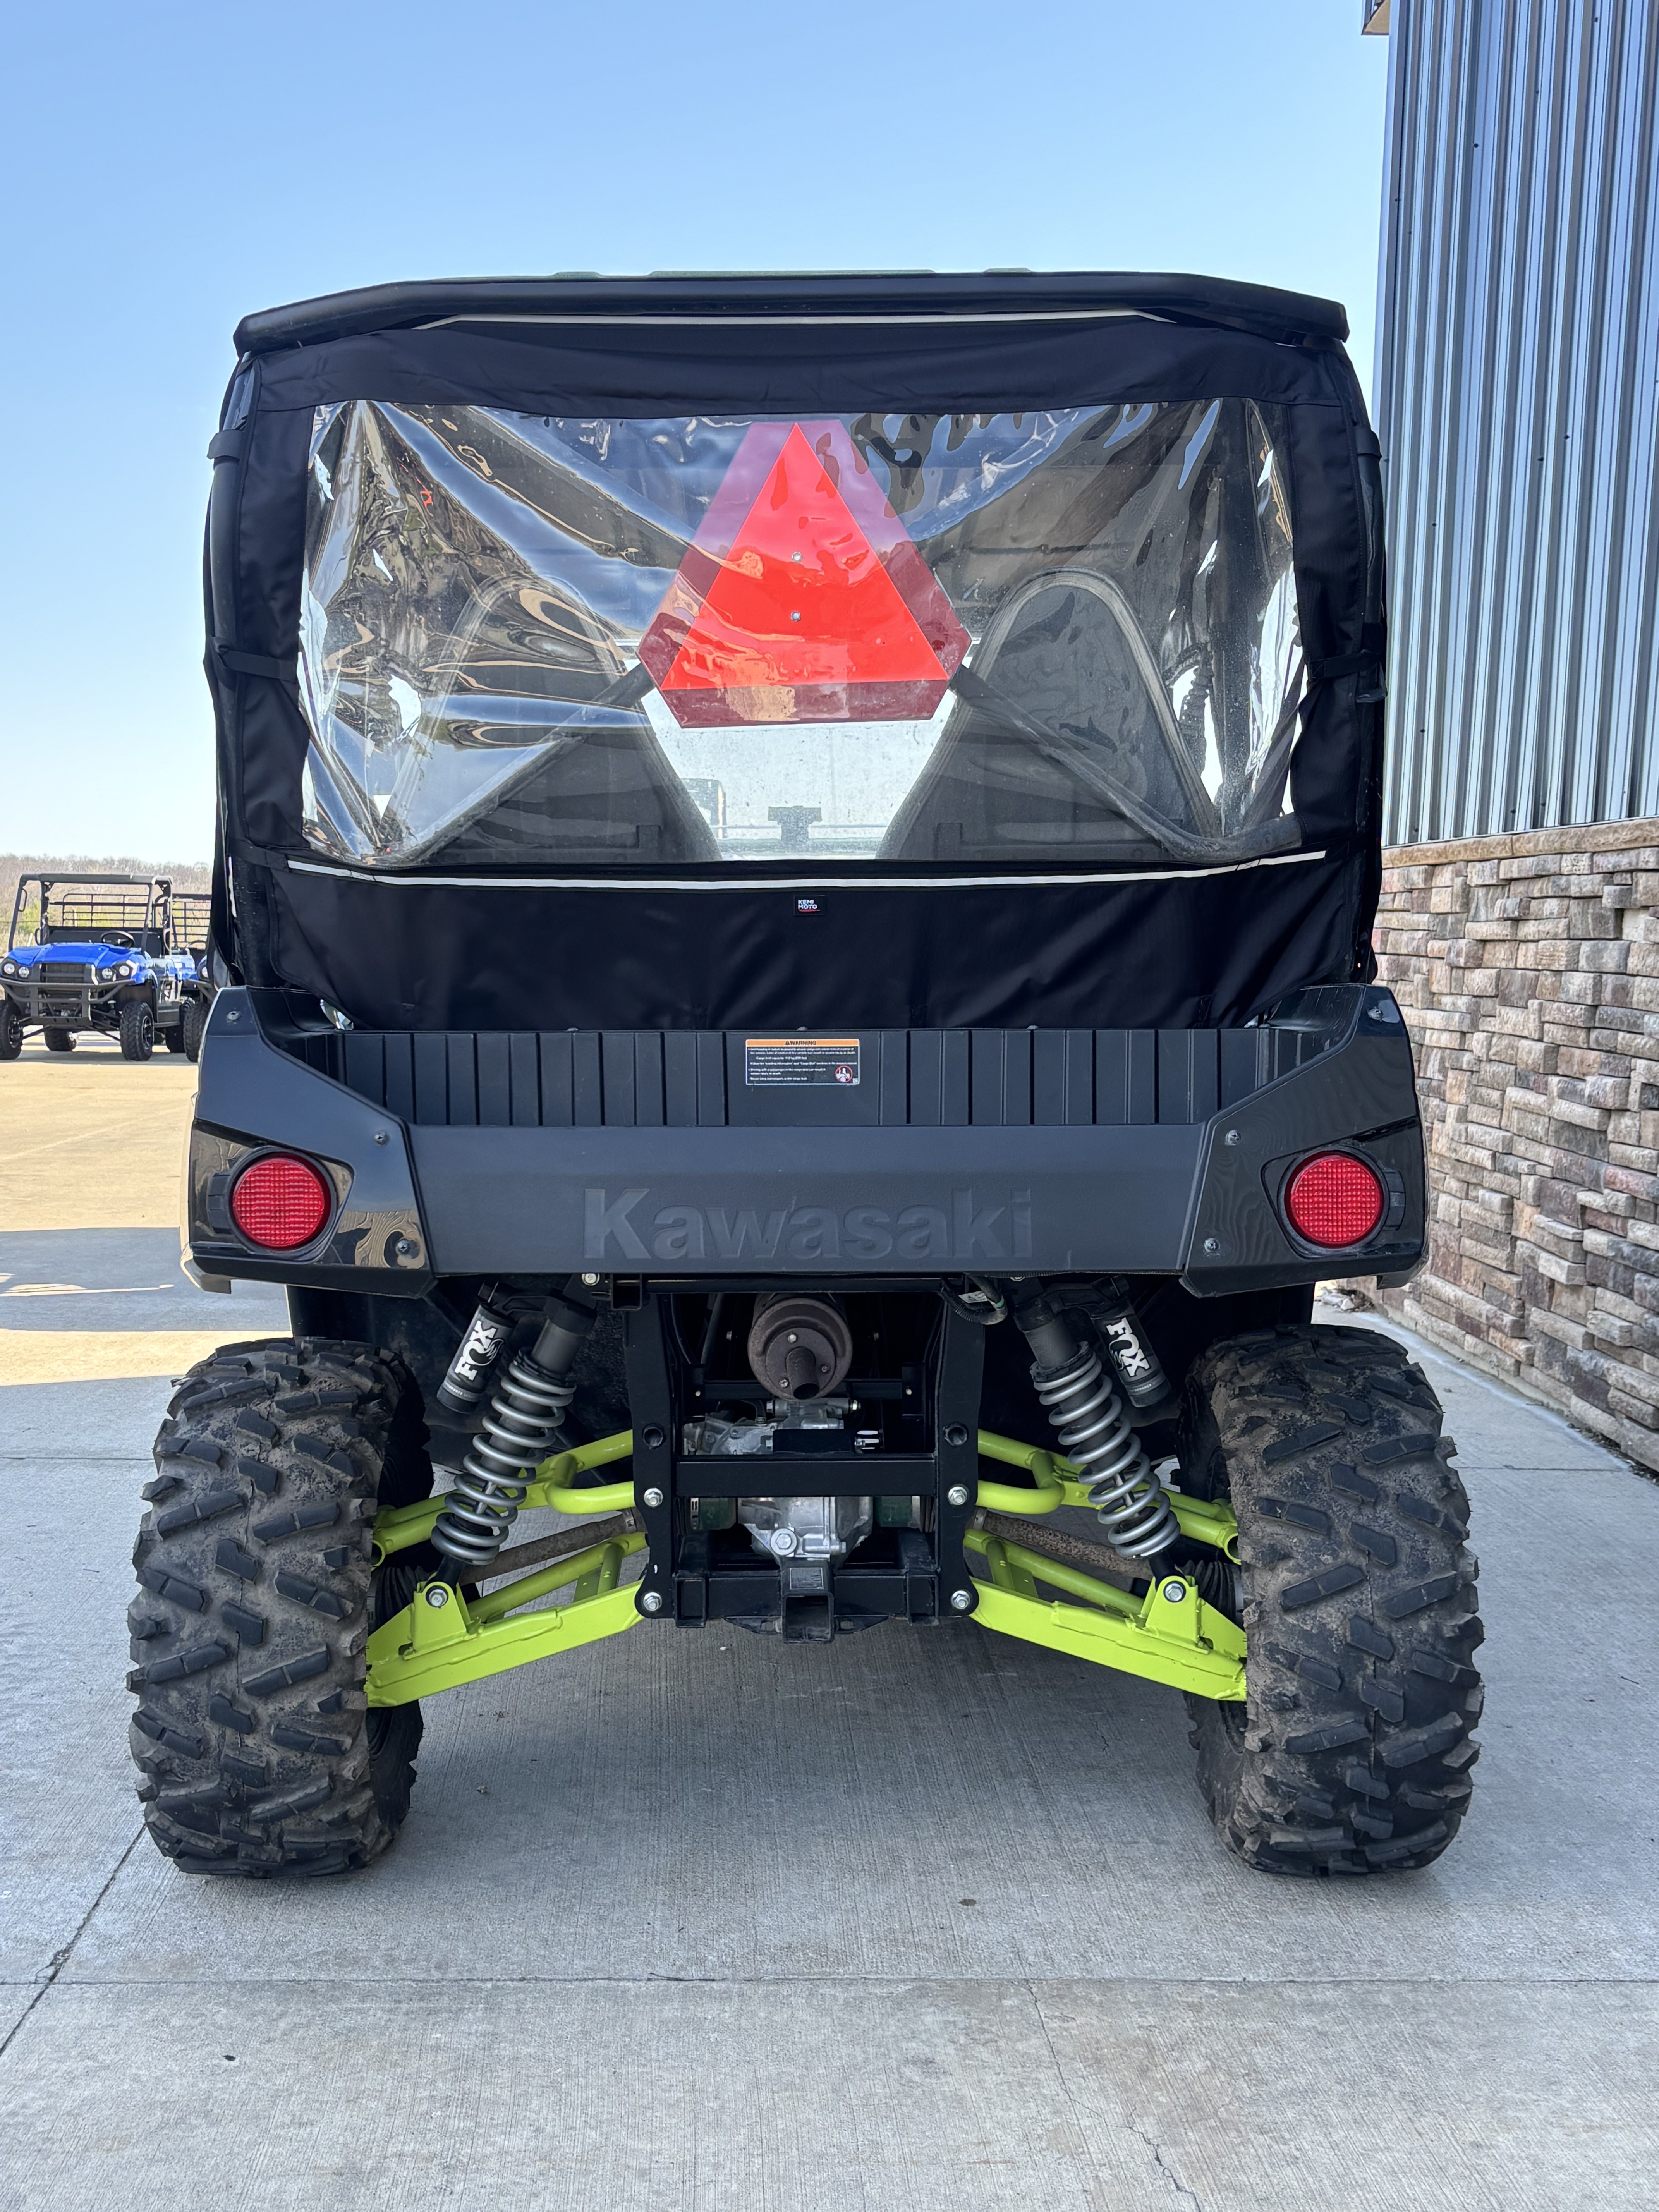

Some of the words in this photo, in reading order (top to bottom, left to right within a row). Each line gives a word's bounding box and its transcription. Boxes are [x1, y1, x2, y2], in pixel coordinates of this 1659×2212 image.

[584, 1188, 1033, 1259] Kawasaki
[454, 1320, 505, 1381] FOX
[1106, 1317, 1151, 1377] FOX
